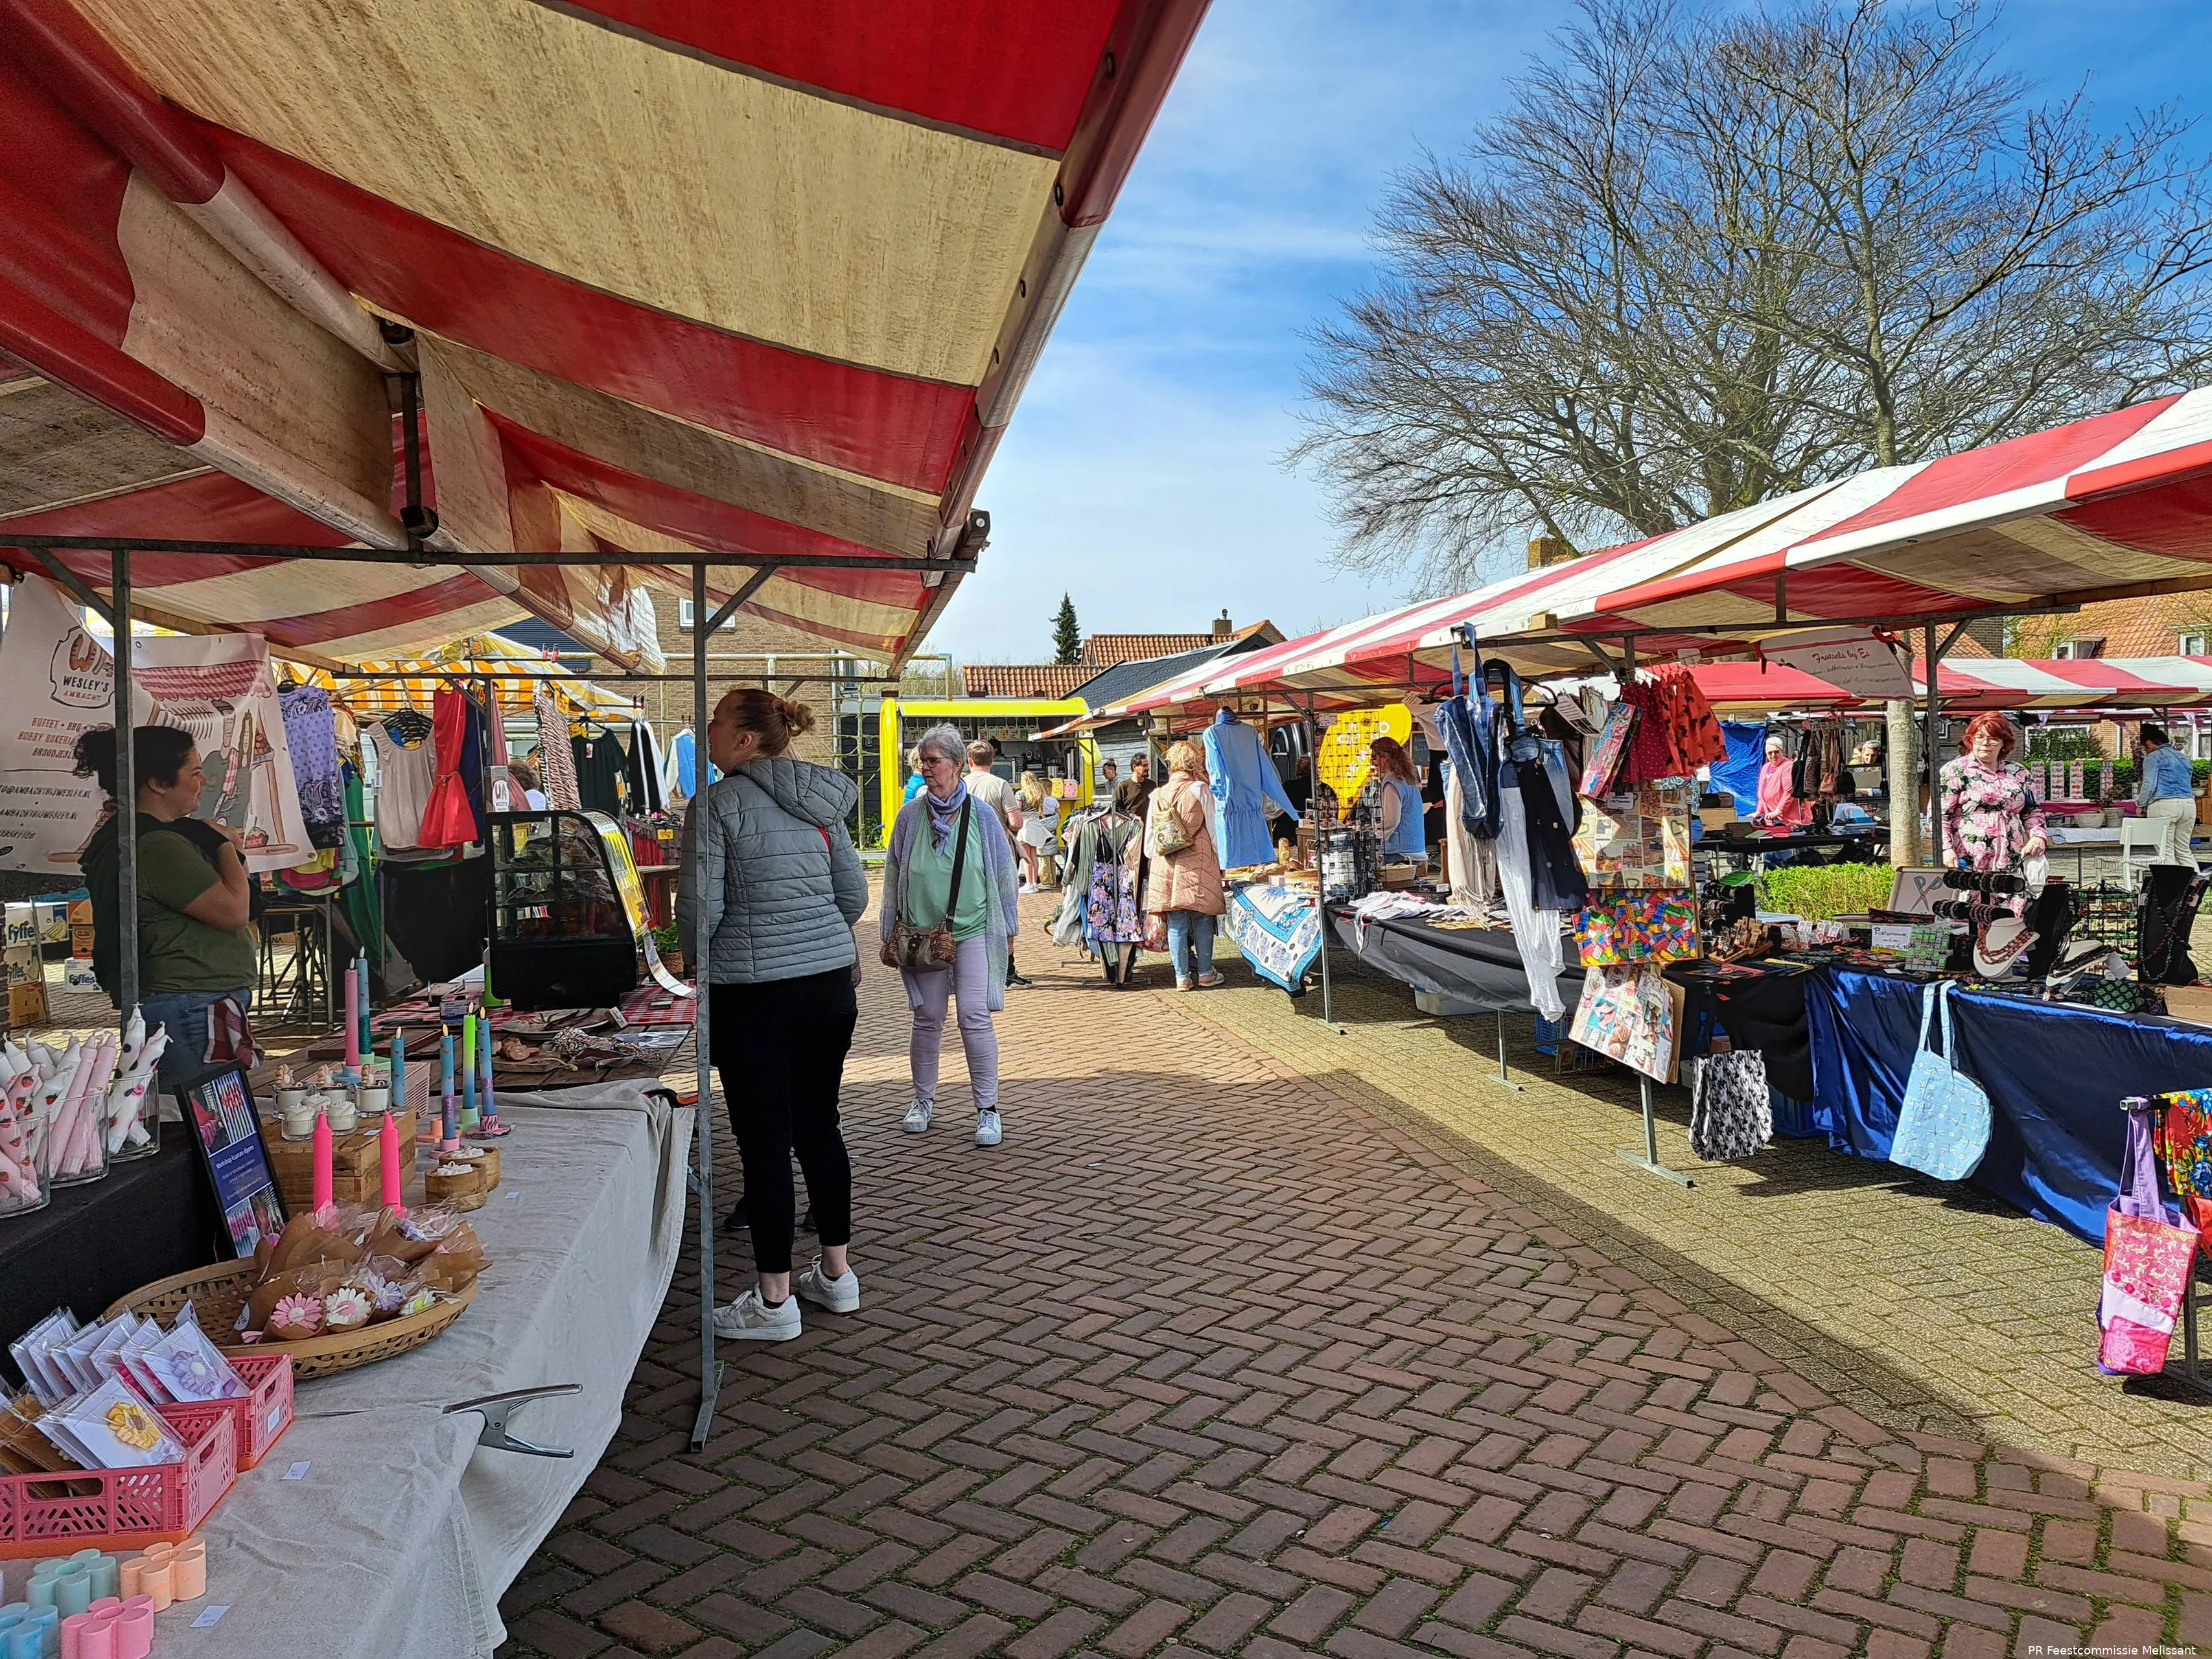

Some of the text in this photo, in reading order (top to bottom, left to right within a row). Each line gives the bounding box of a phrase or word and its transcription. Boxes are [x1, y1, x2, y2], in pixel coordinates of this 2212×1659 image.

[63, 675, 109, 692] WESLEY'S
[63, 690, 102, 701] AMBACHT
[31, 717, 60, 729] BUFFET
[17, 730, 45, 742] HOBBY
